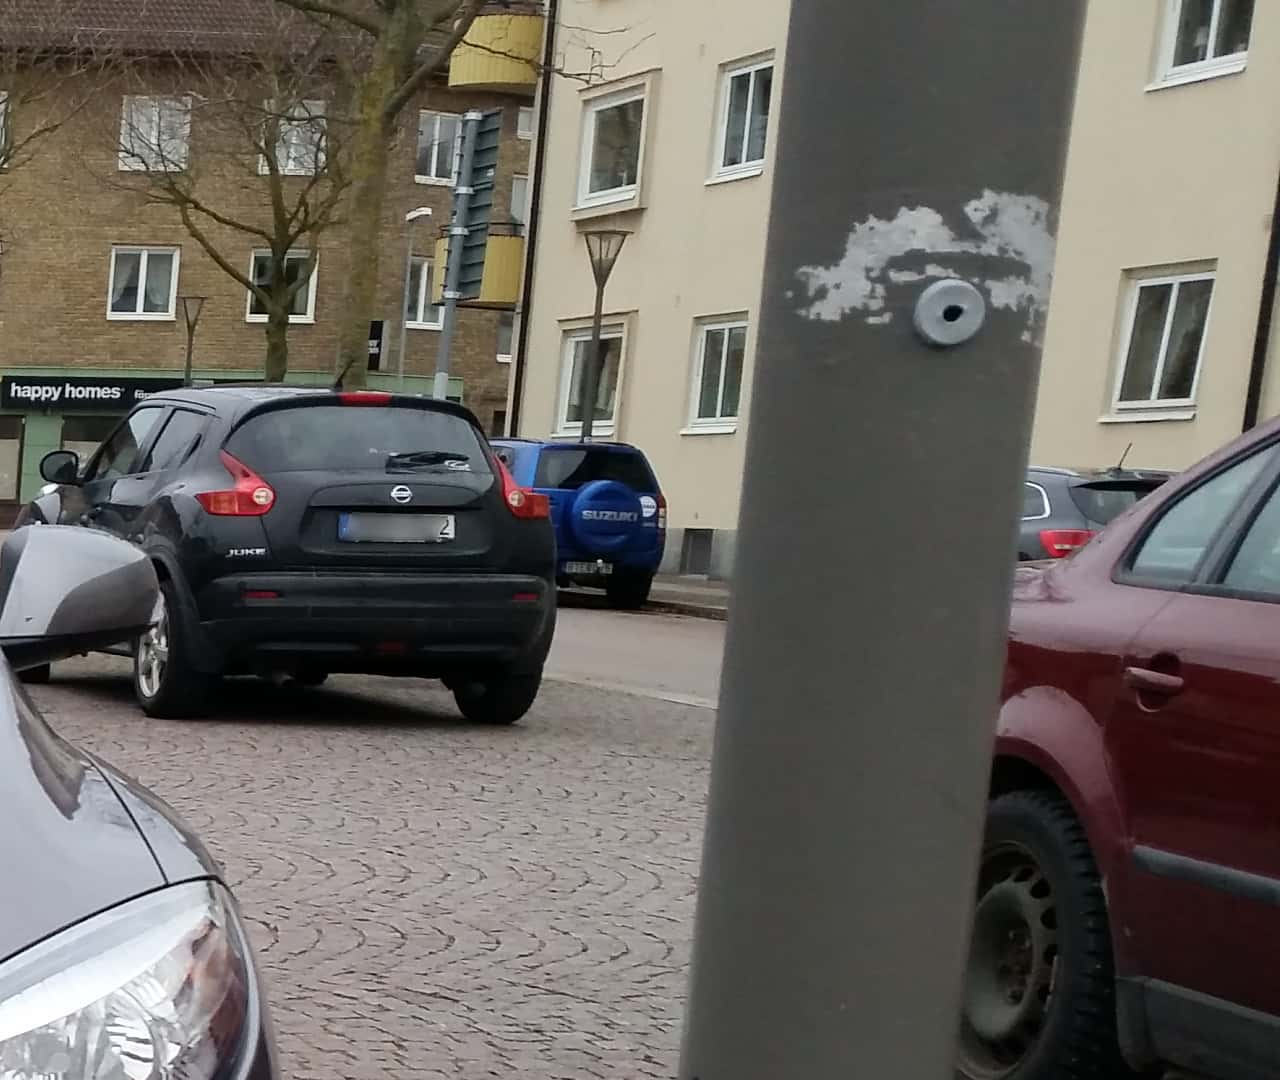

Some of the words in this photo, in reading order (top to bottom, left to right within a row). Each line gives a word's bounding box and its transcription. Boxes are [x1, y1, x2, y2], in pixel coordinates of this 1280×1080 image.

[11, 382, 62, 401] happy
[65, 383, 121, 399] homes
[582, 510, 638, 522] SUZUKI
[225, 548, 266, 558] JUKE
